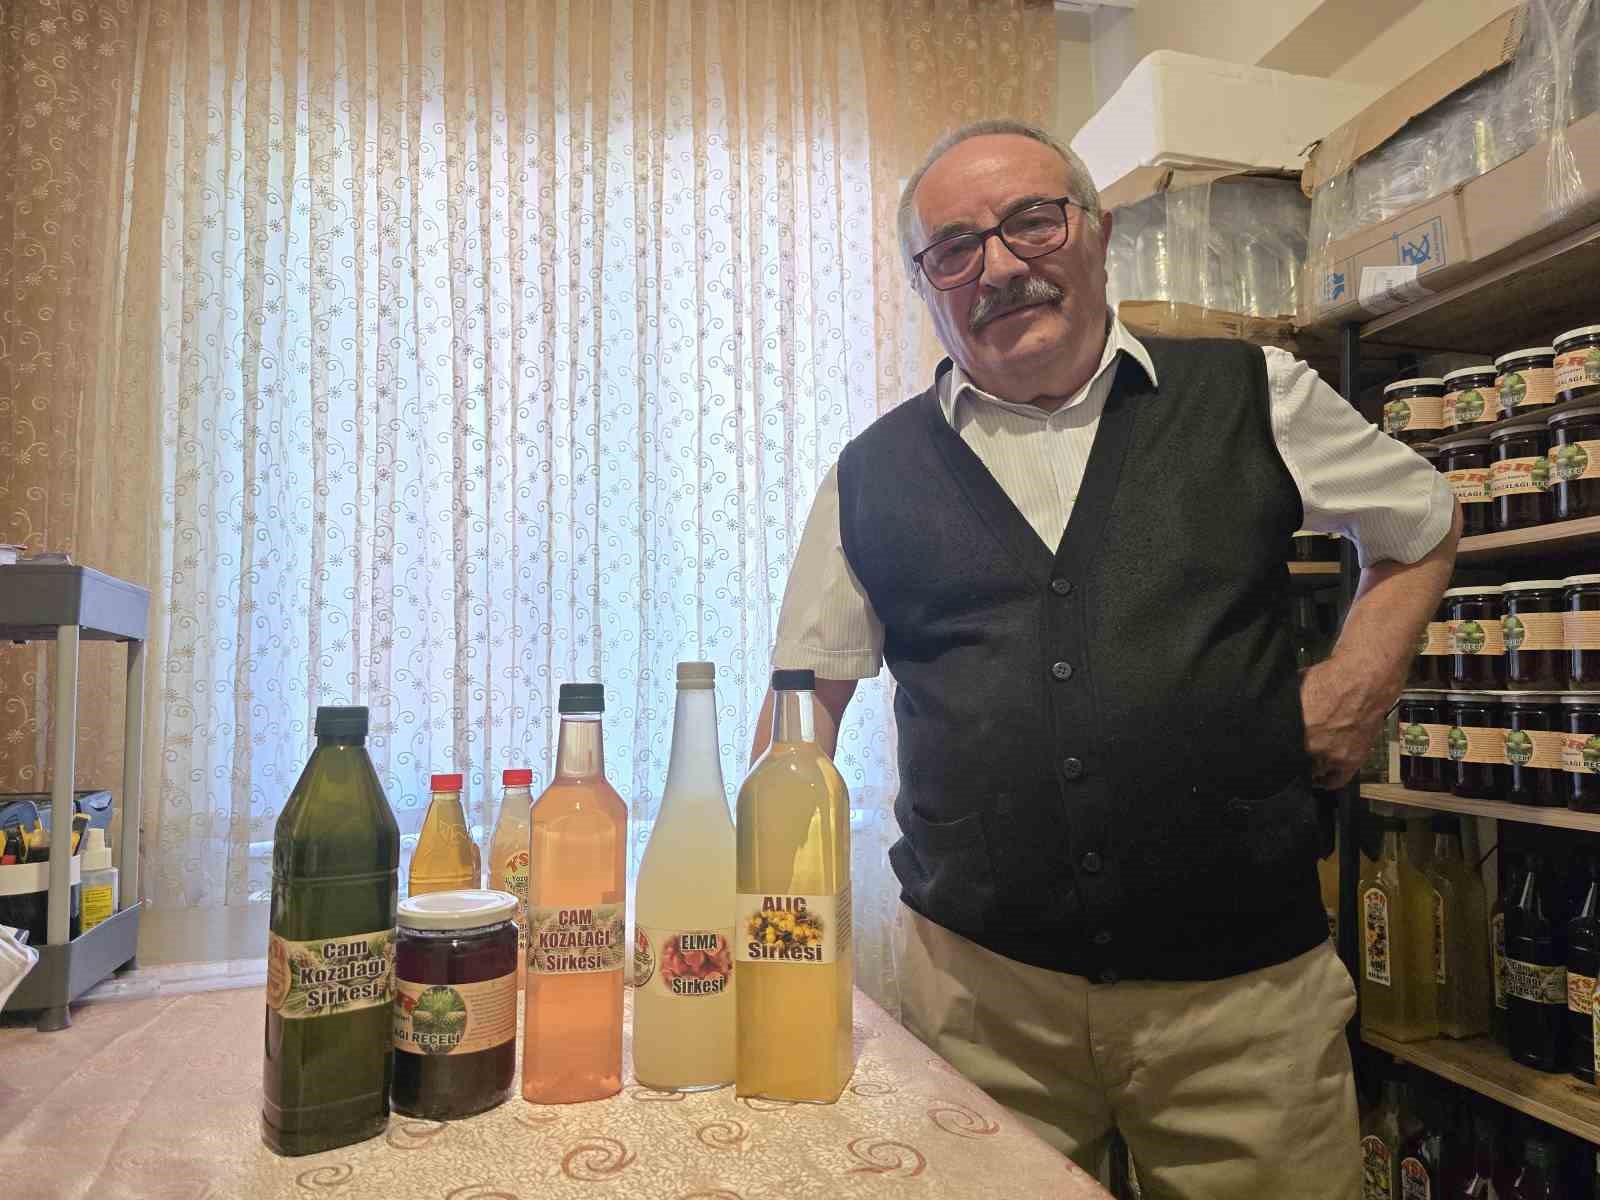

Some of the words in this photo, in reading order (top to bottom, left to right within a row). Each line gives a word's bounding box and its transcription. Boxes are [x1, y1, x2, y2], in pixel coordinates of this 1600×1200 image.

[681, 934, 718, 950] ELMA
[747, 941, 822, 961] Sirkesi
[546, 953, 602, 971] Sirkesi
[672, 976, 725, 994] Sirkesi
